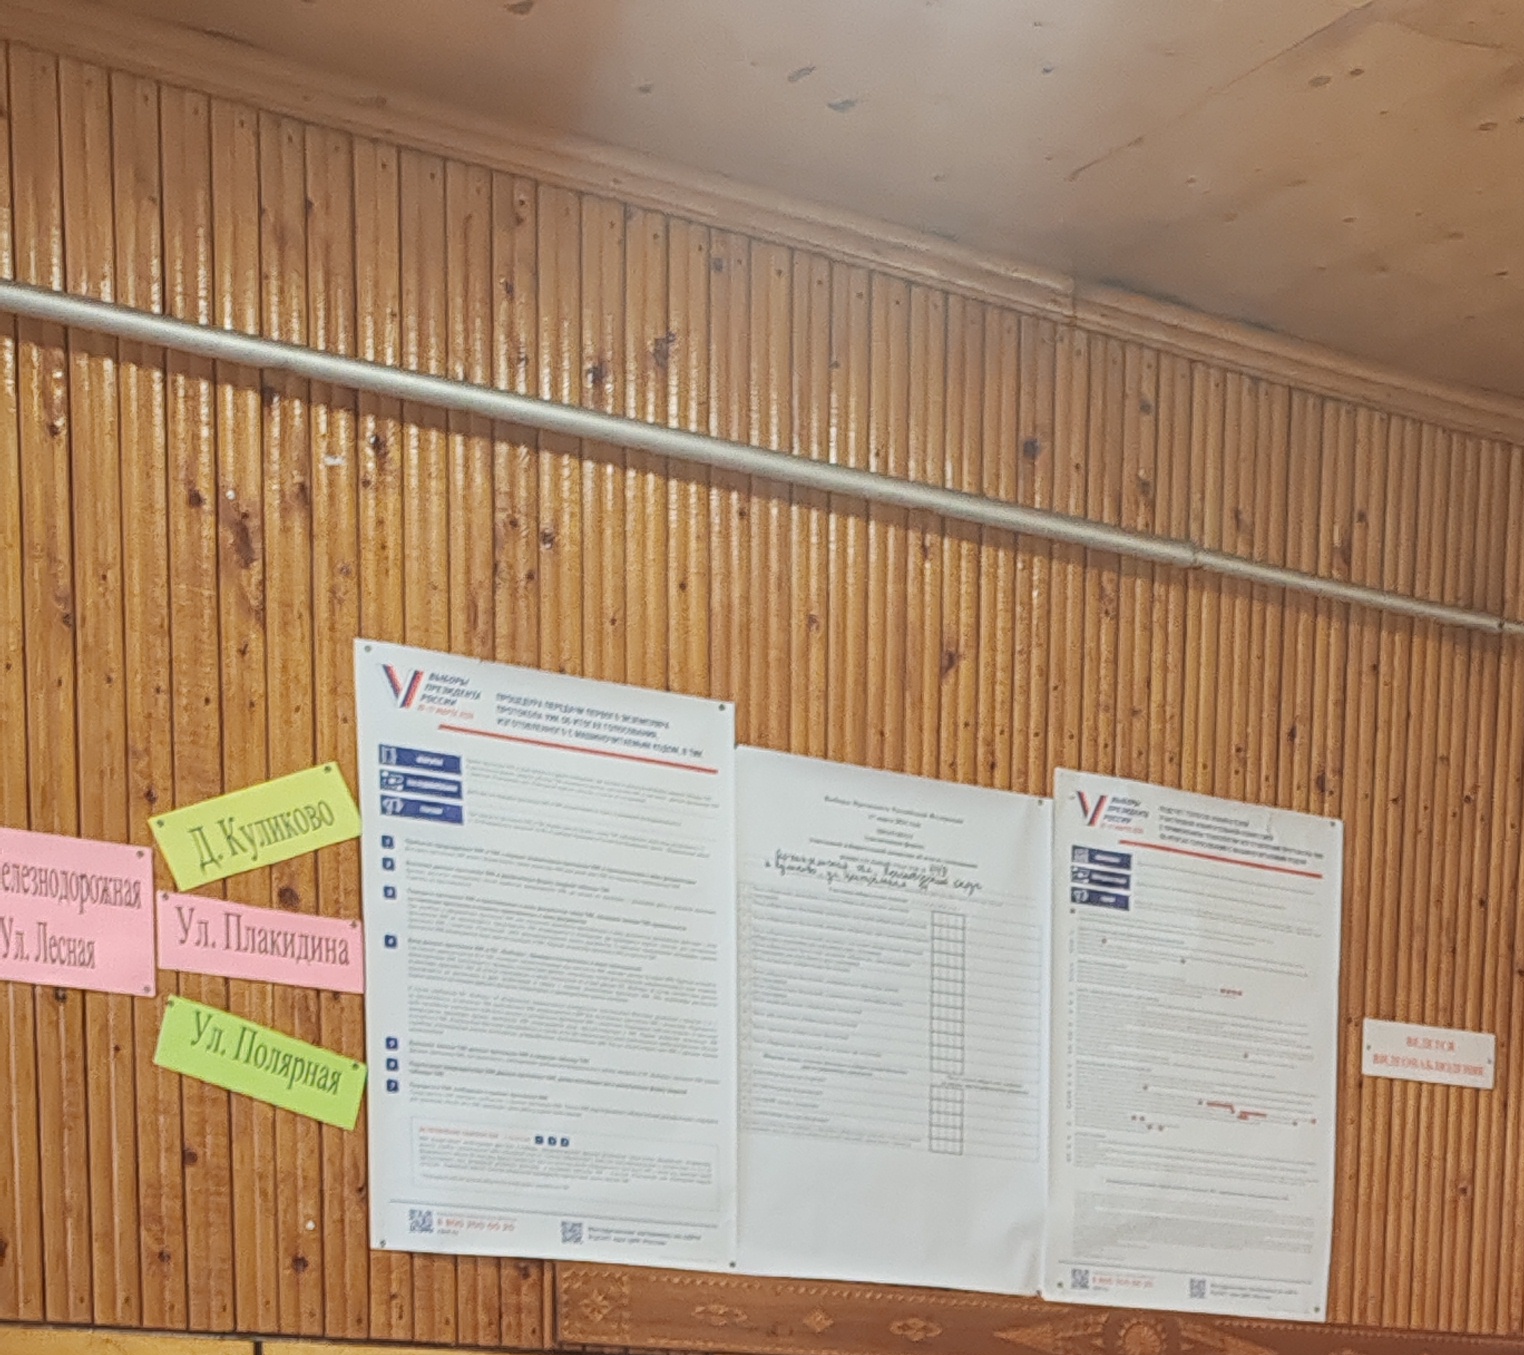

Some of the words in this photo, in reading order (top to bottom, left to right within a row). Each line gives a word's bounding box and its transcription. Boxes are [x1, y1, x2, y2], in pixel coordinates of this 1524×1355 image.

[187, 825, 224, 876] Д.
[217, 800, 335, 862] Куликово
[0, 917, 30, 961] Ул.
[34, 921, 96, 969] Лесная
[174, 906, 217, 949] Ул.
[224, 912, 351, 967] Плакидина
[190, 1011, 227, 1056] Ул.
[233, 1025, 343, 1095] Полярная
